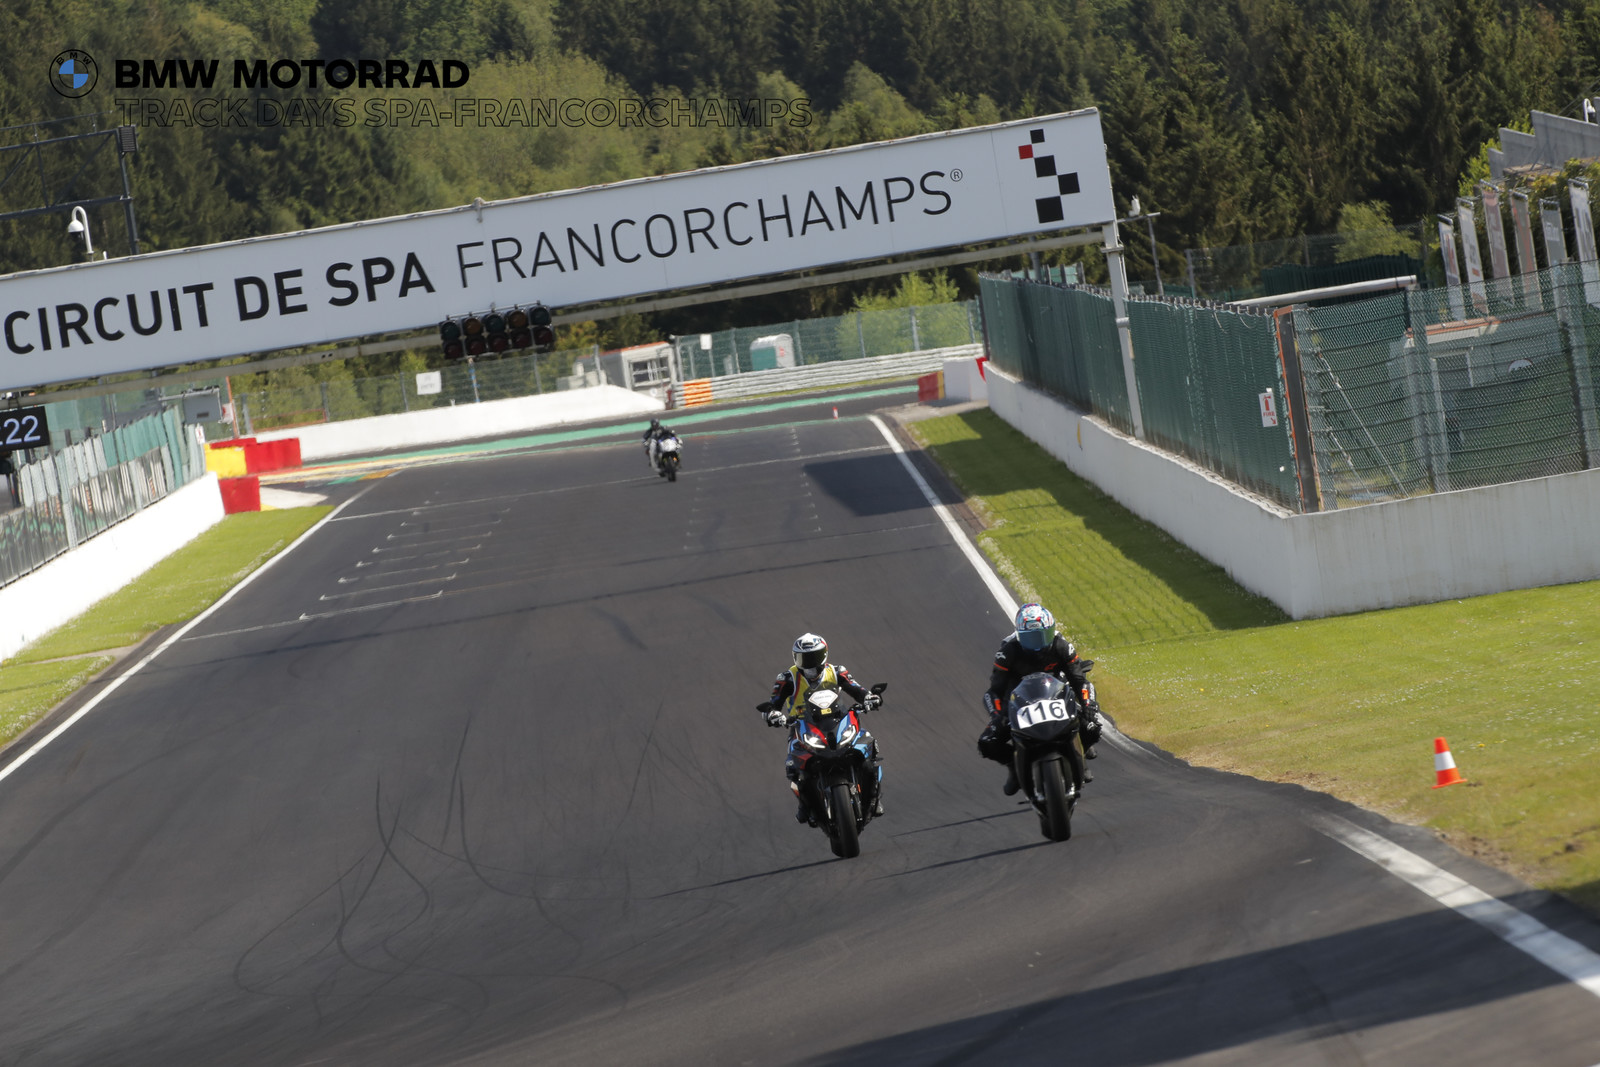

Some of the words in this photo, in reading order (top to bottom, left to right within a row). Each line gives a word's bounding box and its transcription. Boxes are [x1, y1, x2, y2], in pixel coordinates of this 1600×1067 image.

[4, 282, 214, 355] CIRCUIT
[234, 268, 309, 321] DE
[326, 252, 436, 307] SPA
[1021, 701, 1066, 726] 116
